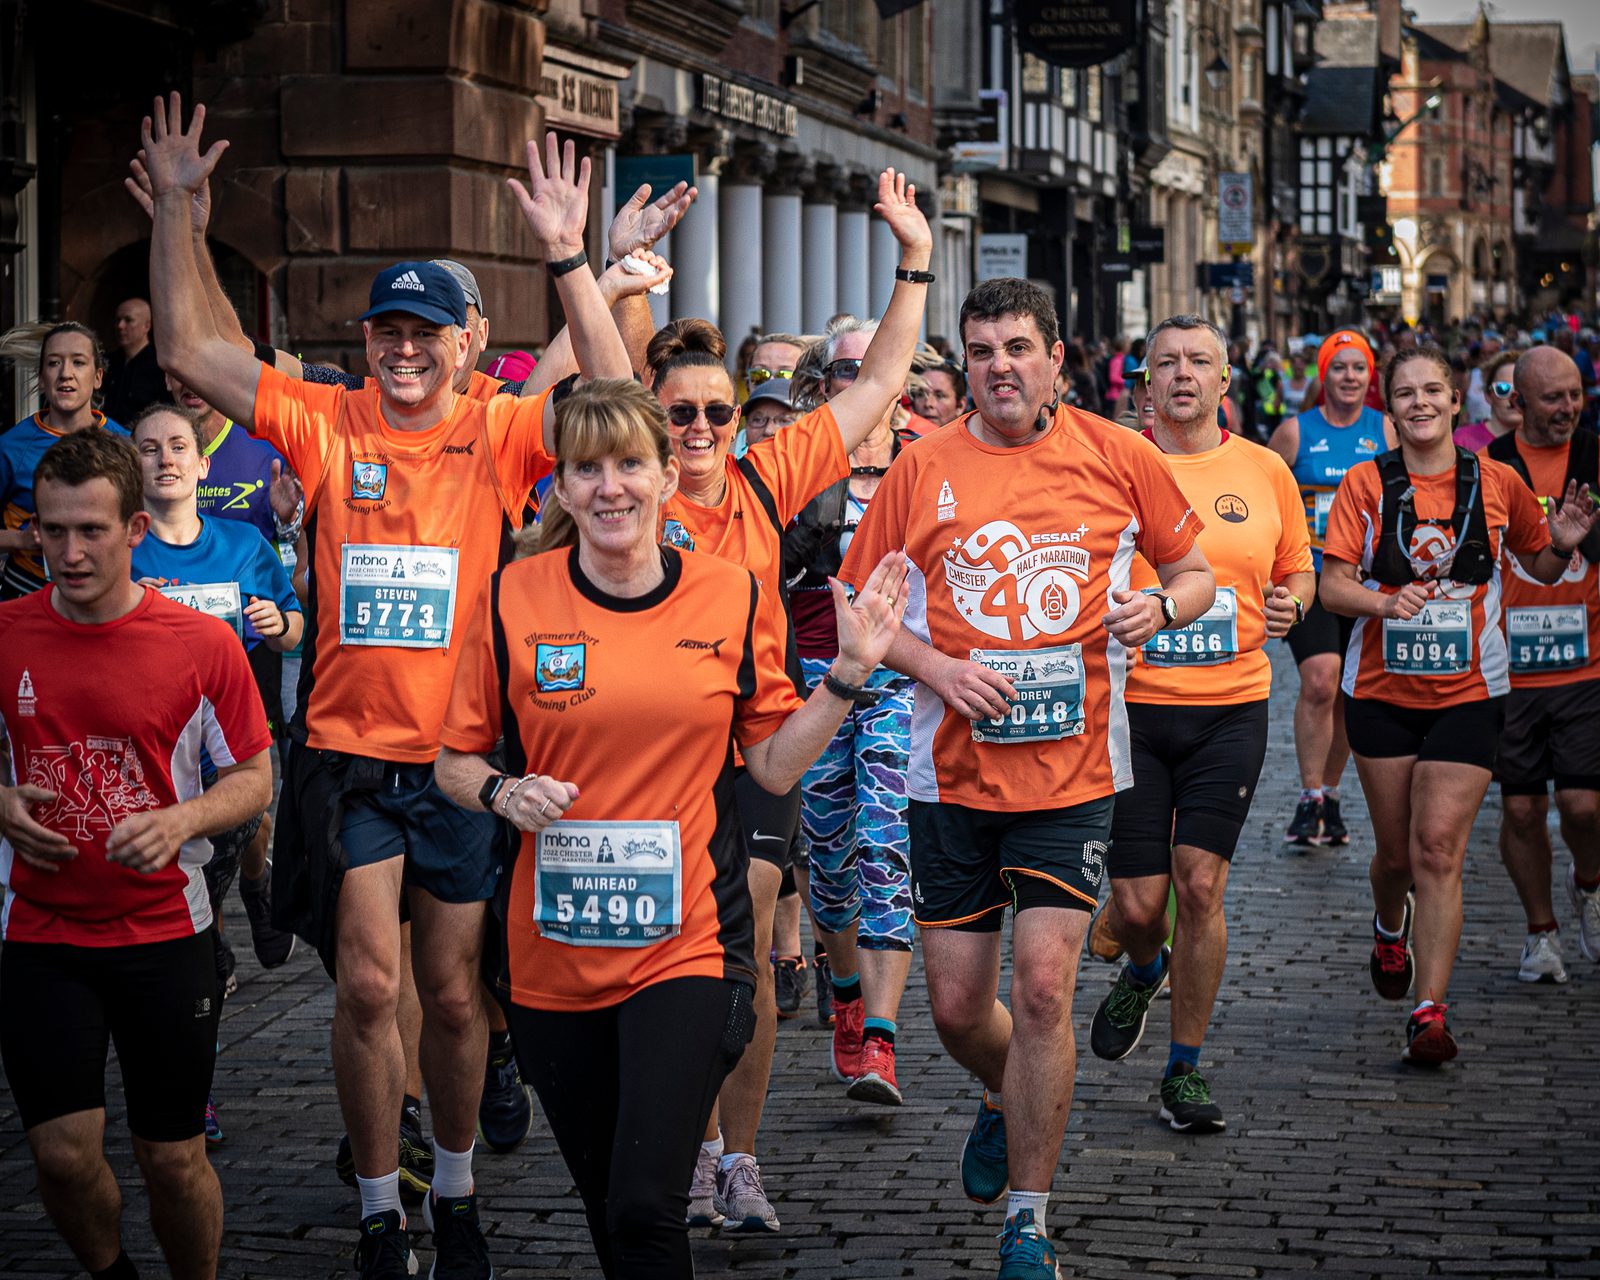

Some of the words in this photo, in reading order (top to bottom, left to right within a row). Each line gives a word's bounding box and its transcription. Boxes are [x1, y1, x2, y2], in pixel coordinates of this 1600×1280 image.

[391, 280, 425, 292] adidas
[197, 485, 231, 497] hletes
[372, 499, 392, 512] Club
[1031, 533, 1081, 544] ESSAR
[351, 554, 388, 566] mbna
[1016, 555, 1038, 576] HALF
[1040, 550, 1087, 566] MARATHON
[949, 566, 987, 586] CHESTER
[375, 588, 417, 600] STEVEN
[357, 601, 434, 628] 5773
[1176, 622, 1203, 631] AVID
[524, 632, 576, 649] Ellesmere
[577, 630, 600, 647] Port
[1157, 634, 1222, 653] 5366
[1416, 633, 1437, 641] KATE
[1396, 643, 1457, 661] 5094
[1520, 644, 1575, 662] 5746
[528, 689, 566, 712] Running
[570, 687, 596, 707] Club
[1005, 689, 1052, 701] DREW
[544, 833, 590, 848] mbna
[543, 849, 558, 857] 2022
[560, 849, 593, 858] CHESTER
[572, 877, 637, 891] MAIREAD
[557, 894, 656, 925] 5490
